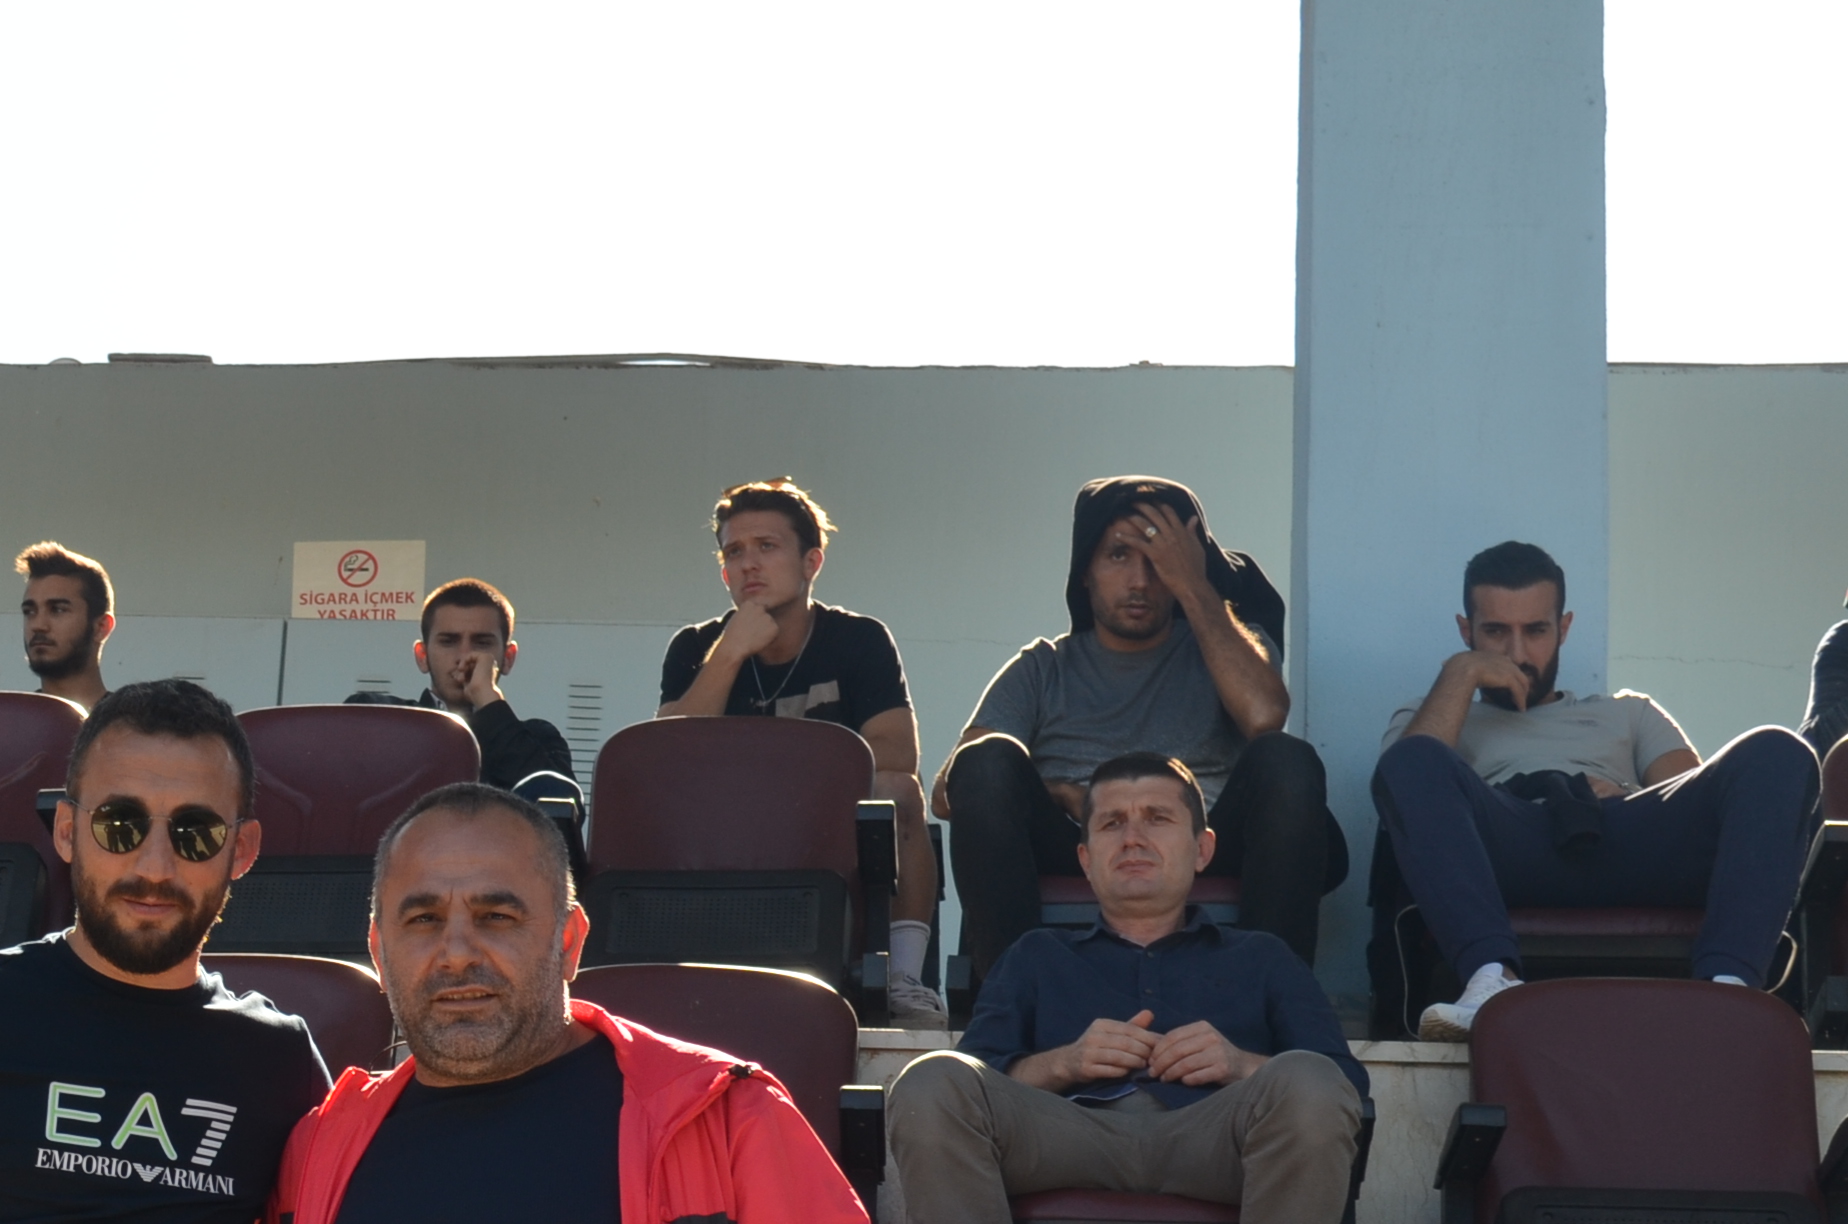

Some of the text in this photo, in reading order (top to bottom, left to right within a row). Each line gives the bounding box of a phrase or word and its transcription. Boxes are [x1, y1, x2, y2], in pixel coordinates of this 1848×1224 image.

[299, 590, 415, 606] SİGARA İÇMEK
[317, 608, 396, 620] YASAKTIR
[45, 1081, 237, 1166] EA7
[35, 1148, 235, 1196] EMPORIO ARMANI
